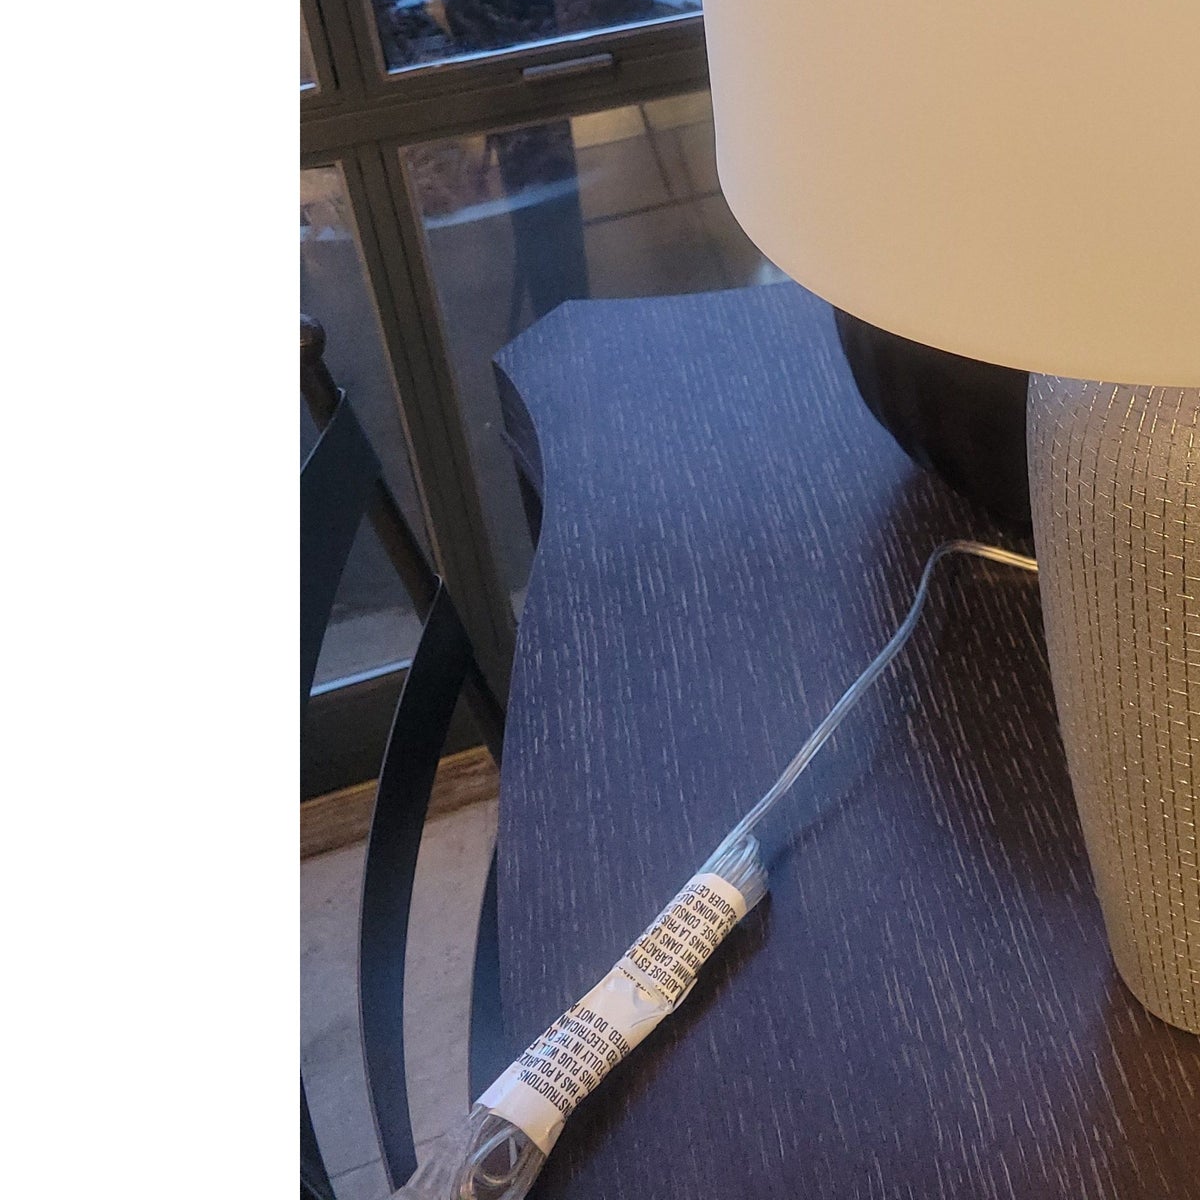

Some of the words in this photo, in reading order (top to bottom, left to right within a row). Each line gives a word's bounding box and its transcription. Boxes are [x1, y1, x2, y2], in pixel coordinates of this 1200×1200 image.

[692, 899, 718, 924] MOINS
[660, 932, 682, 954] DANS
[688, 935, 710, 958] DANS
[634, 953, 651, 971] EST
[575, 1006, 595, 1023] NOT
[554, 1032, 572, 1048] THE
[556, 1014, 609, 1054] ELECTRICIAN
[537, 1042, 558, 1057] WILL
[557, 1051, 582, 1076] PLUG
[580, 1049, 606, 1075] FULLY
[560, 1076, 579, 1096] HAS
[578, 1069, 597, 1092] THIS
[516, 1068, 573, 1117] NSTRUCTIONS
